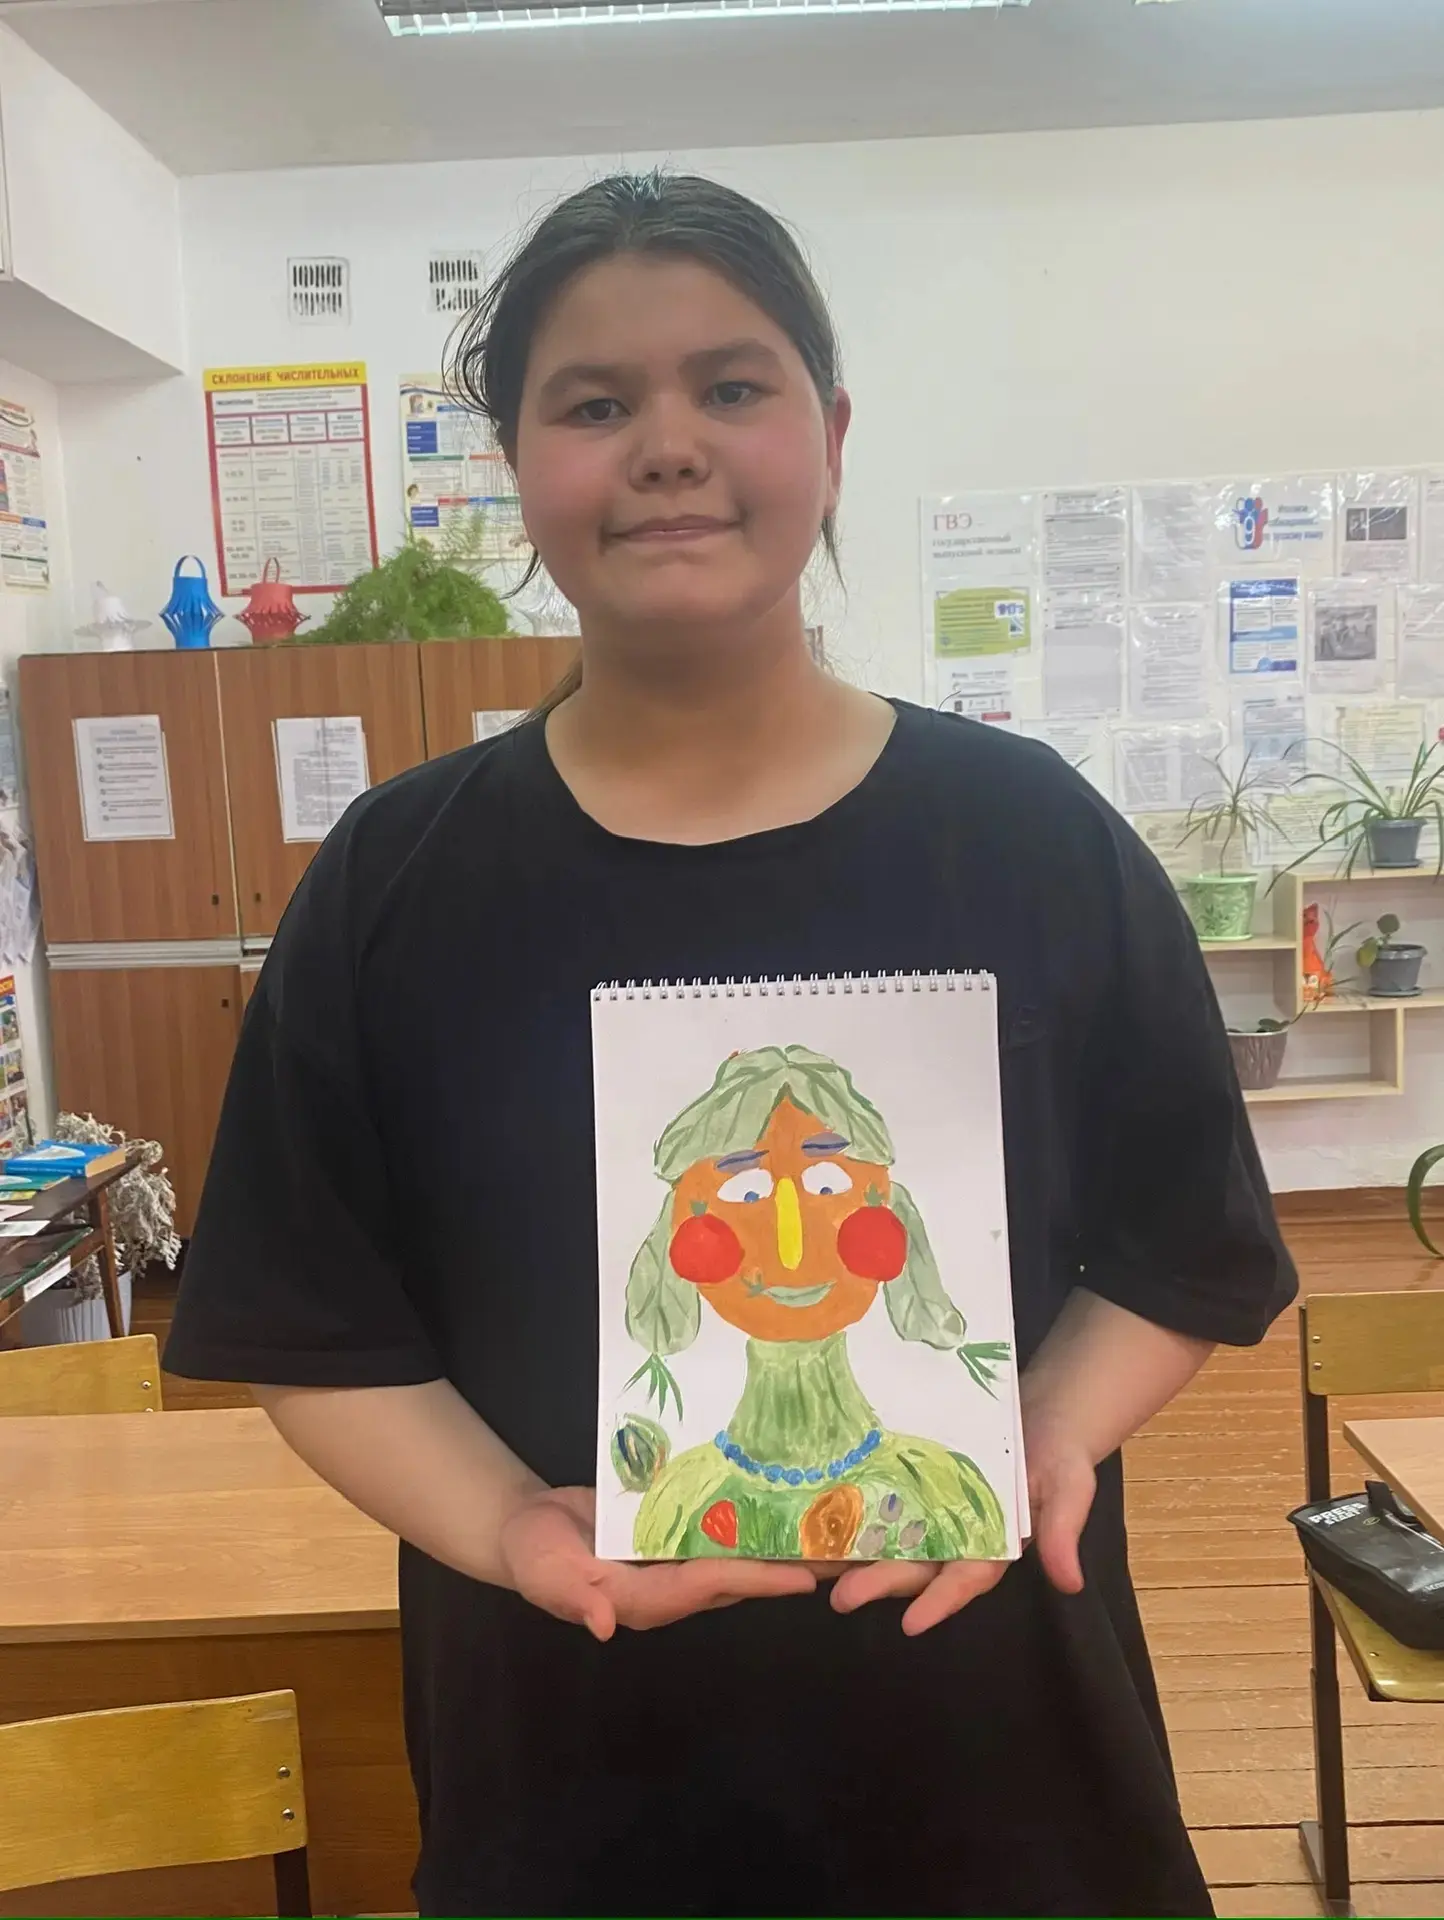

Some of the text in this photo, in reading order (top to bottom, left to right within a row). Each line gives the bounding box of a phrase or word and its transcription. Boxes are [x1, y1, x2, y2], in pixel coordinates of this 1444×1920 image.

[212, 368, 359, 385] СКЛОНЕНИЕ ЧИСЛИТЕЛЬНЫХ
[933, 513, 972, 531] ГВЭ
[1308, 1503, 1367, 1523] PRESS
